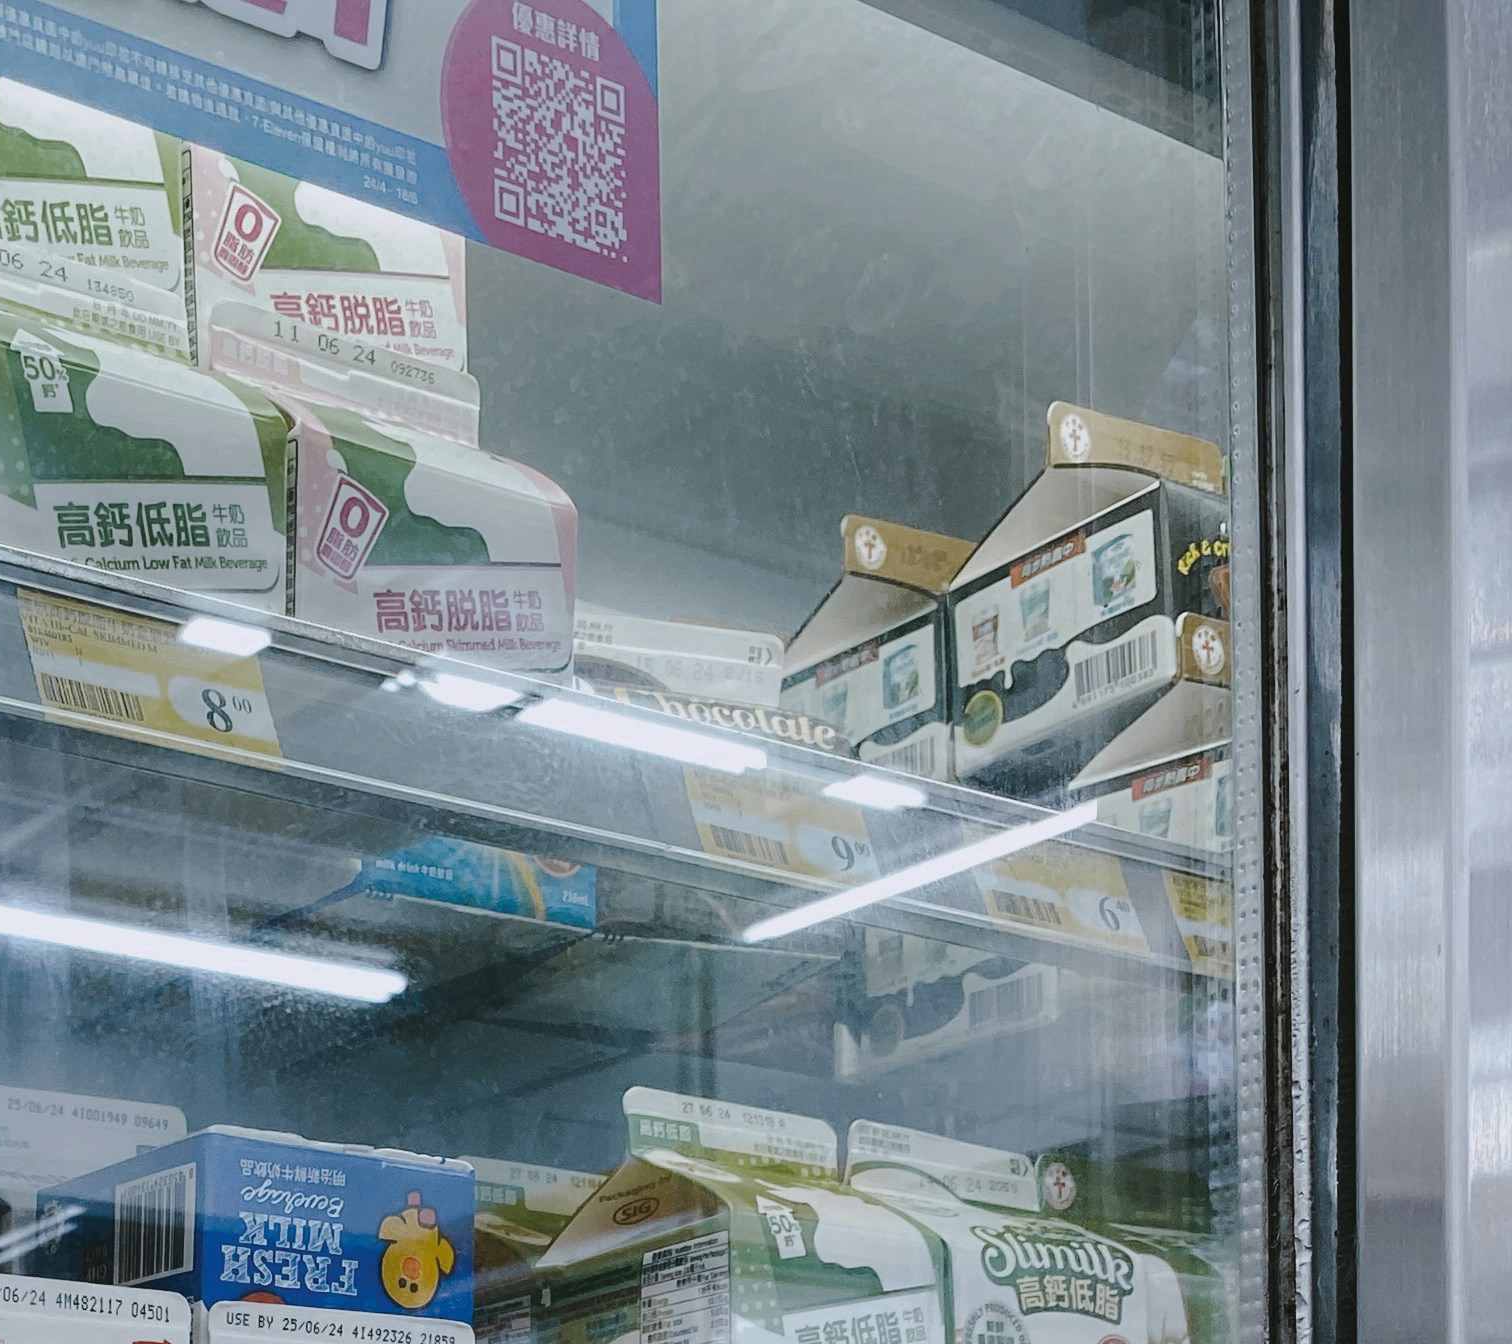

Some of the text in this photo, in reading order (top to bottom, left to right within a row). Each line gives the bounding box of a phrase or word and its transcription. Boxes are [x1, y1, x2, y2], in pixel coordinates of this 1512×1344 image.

[512, 4, 602, 62] 優惠詳情
[39, 260, 68, 282] 24
[53, 502, 211, 549] 高鈣低脂
[212, 503, 245, 526] 牛奶
[216, 528, 248, 548] 飲品
[142, 556, 268, 572] Low Fat Milk Beverage
[202, 687, 233, 736] 8
[240, 1179, 344, 1218] Beverage
[238, 1211, 343, 1255] MILK
[220, 1245, 359, 1296] FRESH
[131, 1303, 170, 1323] 04501
[1017, 1276, 1124, 1320] 高鈣低脂
[226, 1312, 250, 1327] USE
[257, 1314, 274, 1330] BY
[282, 1318, 344, 1338] 25/06/24
